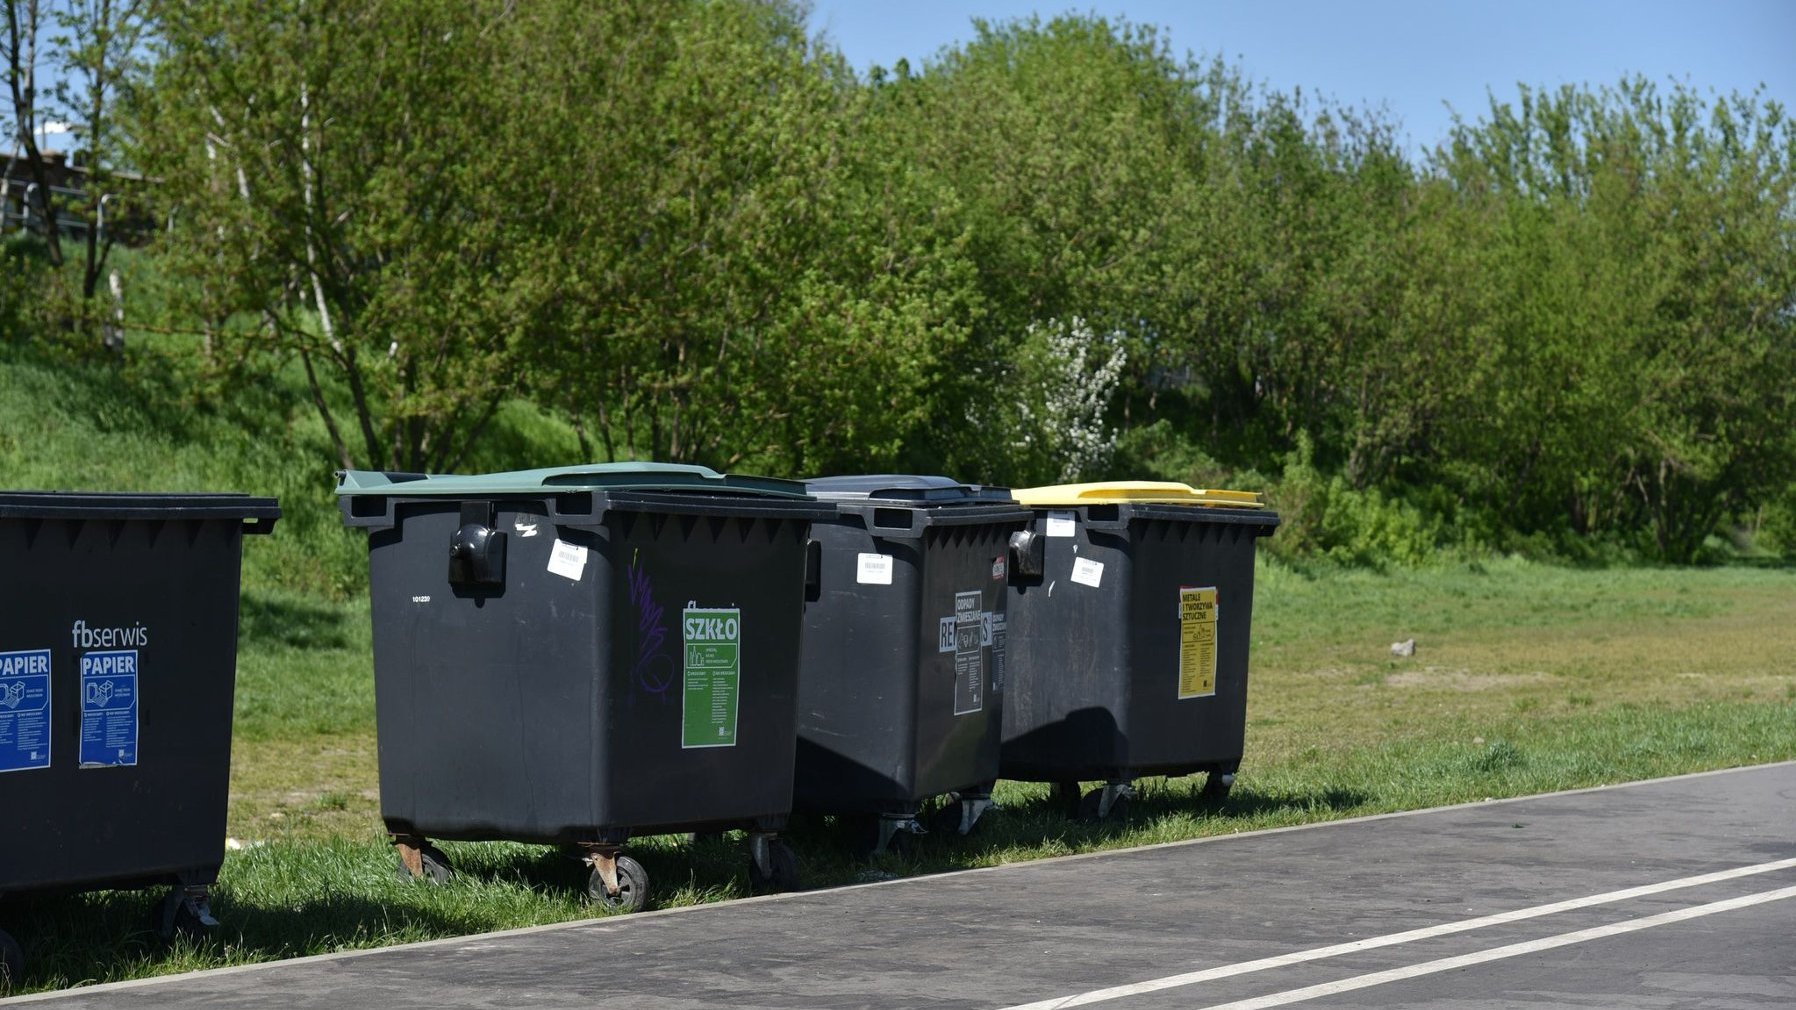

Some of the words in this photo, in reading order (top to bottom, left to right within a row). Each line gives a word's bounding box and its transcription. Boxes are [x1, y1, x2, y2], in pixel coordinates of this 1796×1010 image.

[1182, 593, 1201, 602] METALE
[1182, 611, 1207, 621] SZTUCZNE
[72, 620, 148, 648] fbserwis
[685, 618, 738, 640] SZKŁO
[0, 655, 48, 676] APIER
[82, 656, 135, 675] PAPIER
